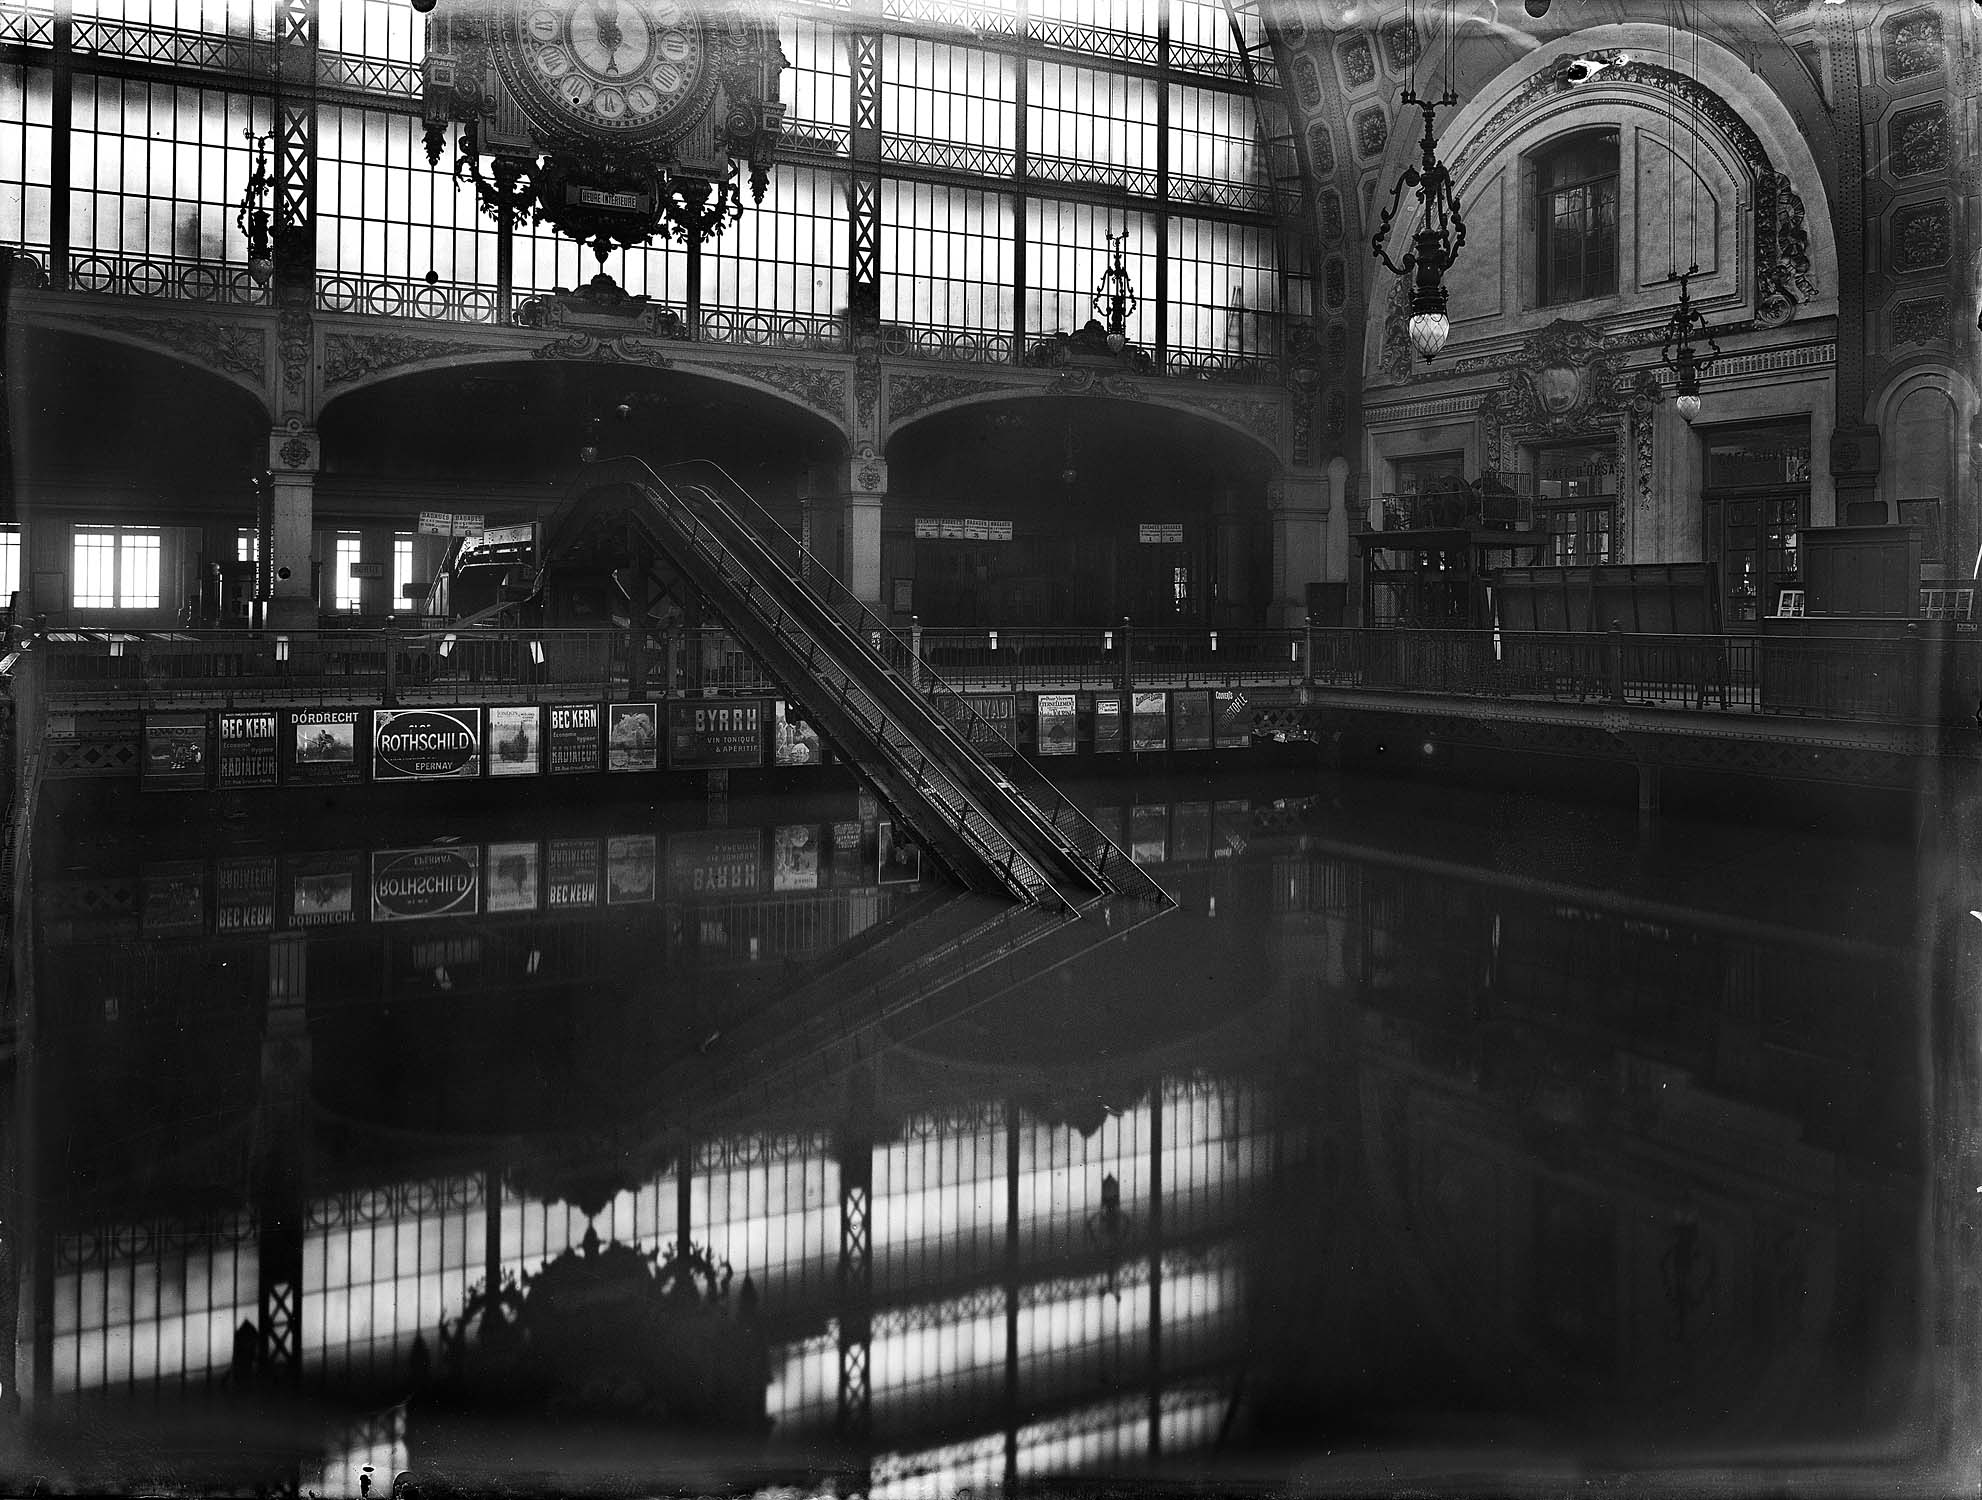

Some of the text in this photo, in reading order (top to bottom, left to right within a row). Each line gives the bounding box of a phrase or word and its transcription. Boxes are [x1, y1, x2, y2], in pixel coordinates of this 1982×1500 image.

[1577, 461, 1616, 478] D'ORSA
[222, 719, 243, 739] BEC
[246, 717, 275, 738] KERN
[552, 710, 570, 729] BEC
[572, 708, 597, 728] KERN
[695, 708, 757, 732] BYRRH
[381, 732, 470, 752] ROTHSCHILD
[723, 735, 756, 744] TONIQUE
[222, 756, 275, 777] RADIATEUR
[415, 762, 453, 771] EPERNAY
